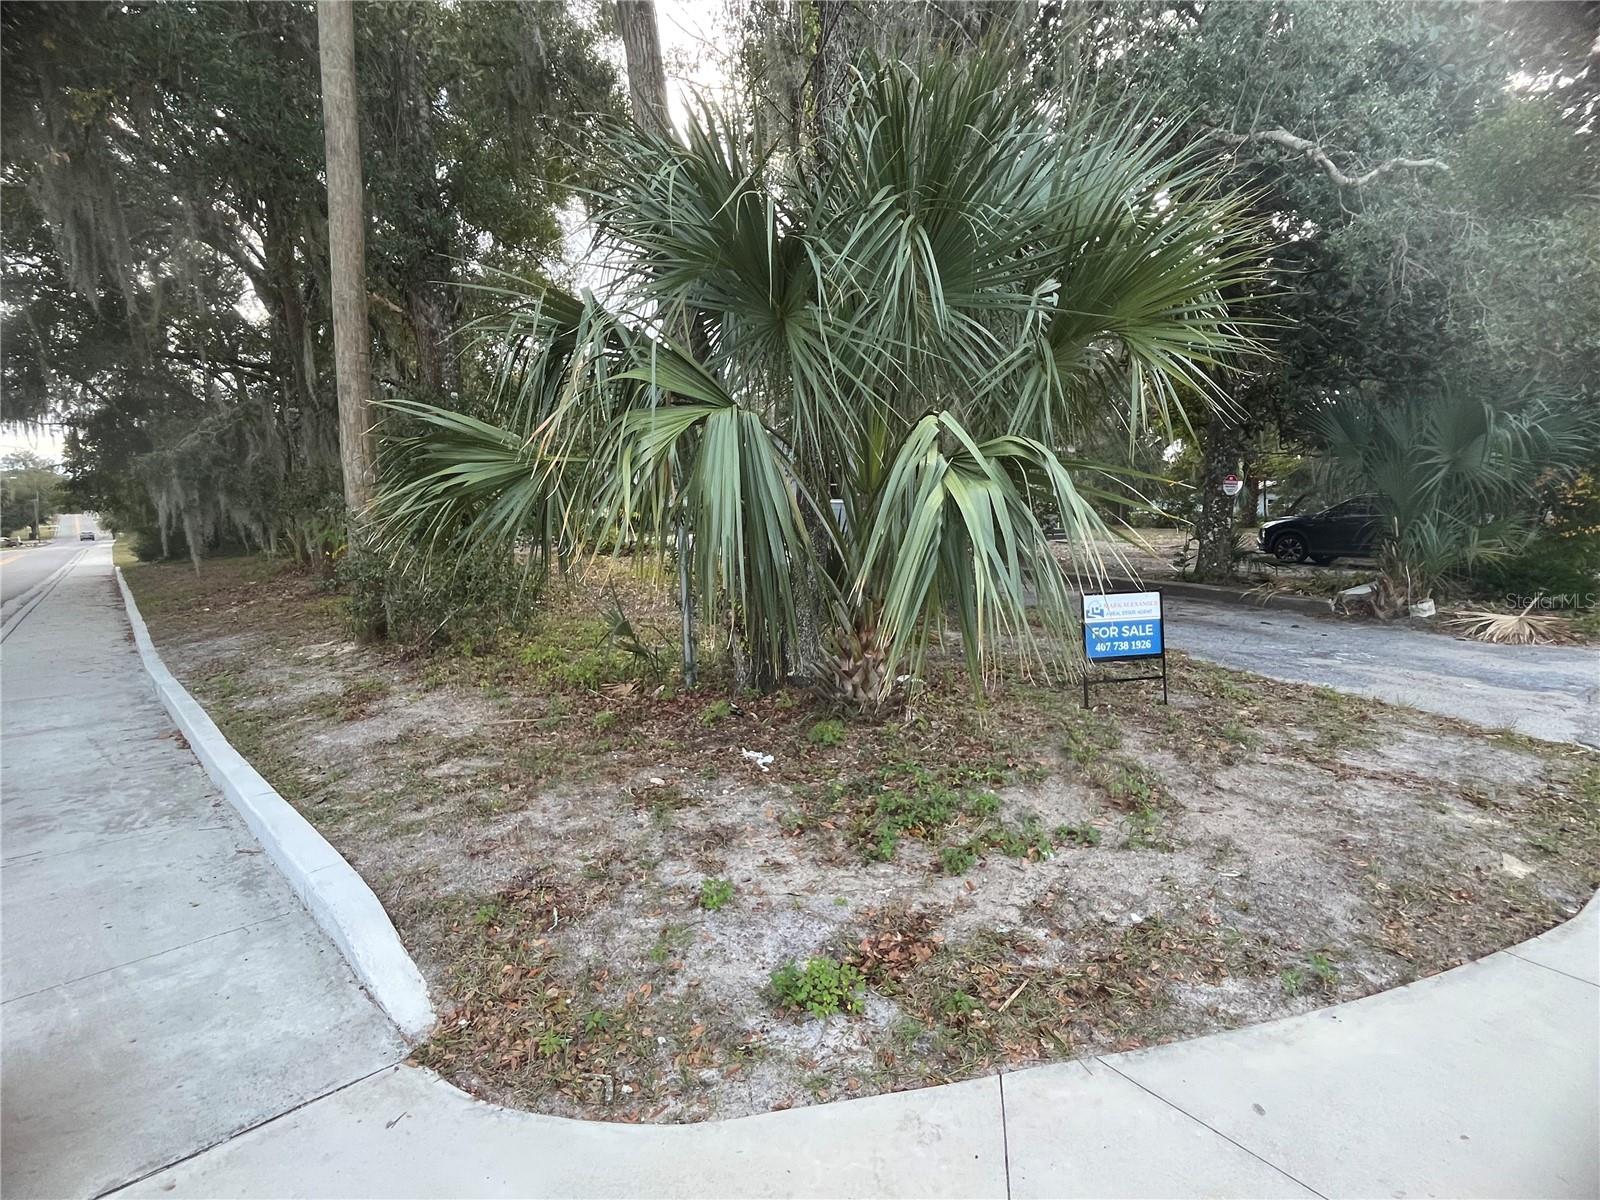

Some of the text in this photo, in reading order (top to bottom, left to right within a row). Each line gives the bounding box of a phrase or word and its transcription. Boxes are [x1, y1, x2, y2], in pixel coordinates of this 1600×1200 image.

[1092, 624, 1154, 639] FOR SALE
[1095, 639, 1151, 652] 407 738 1926
